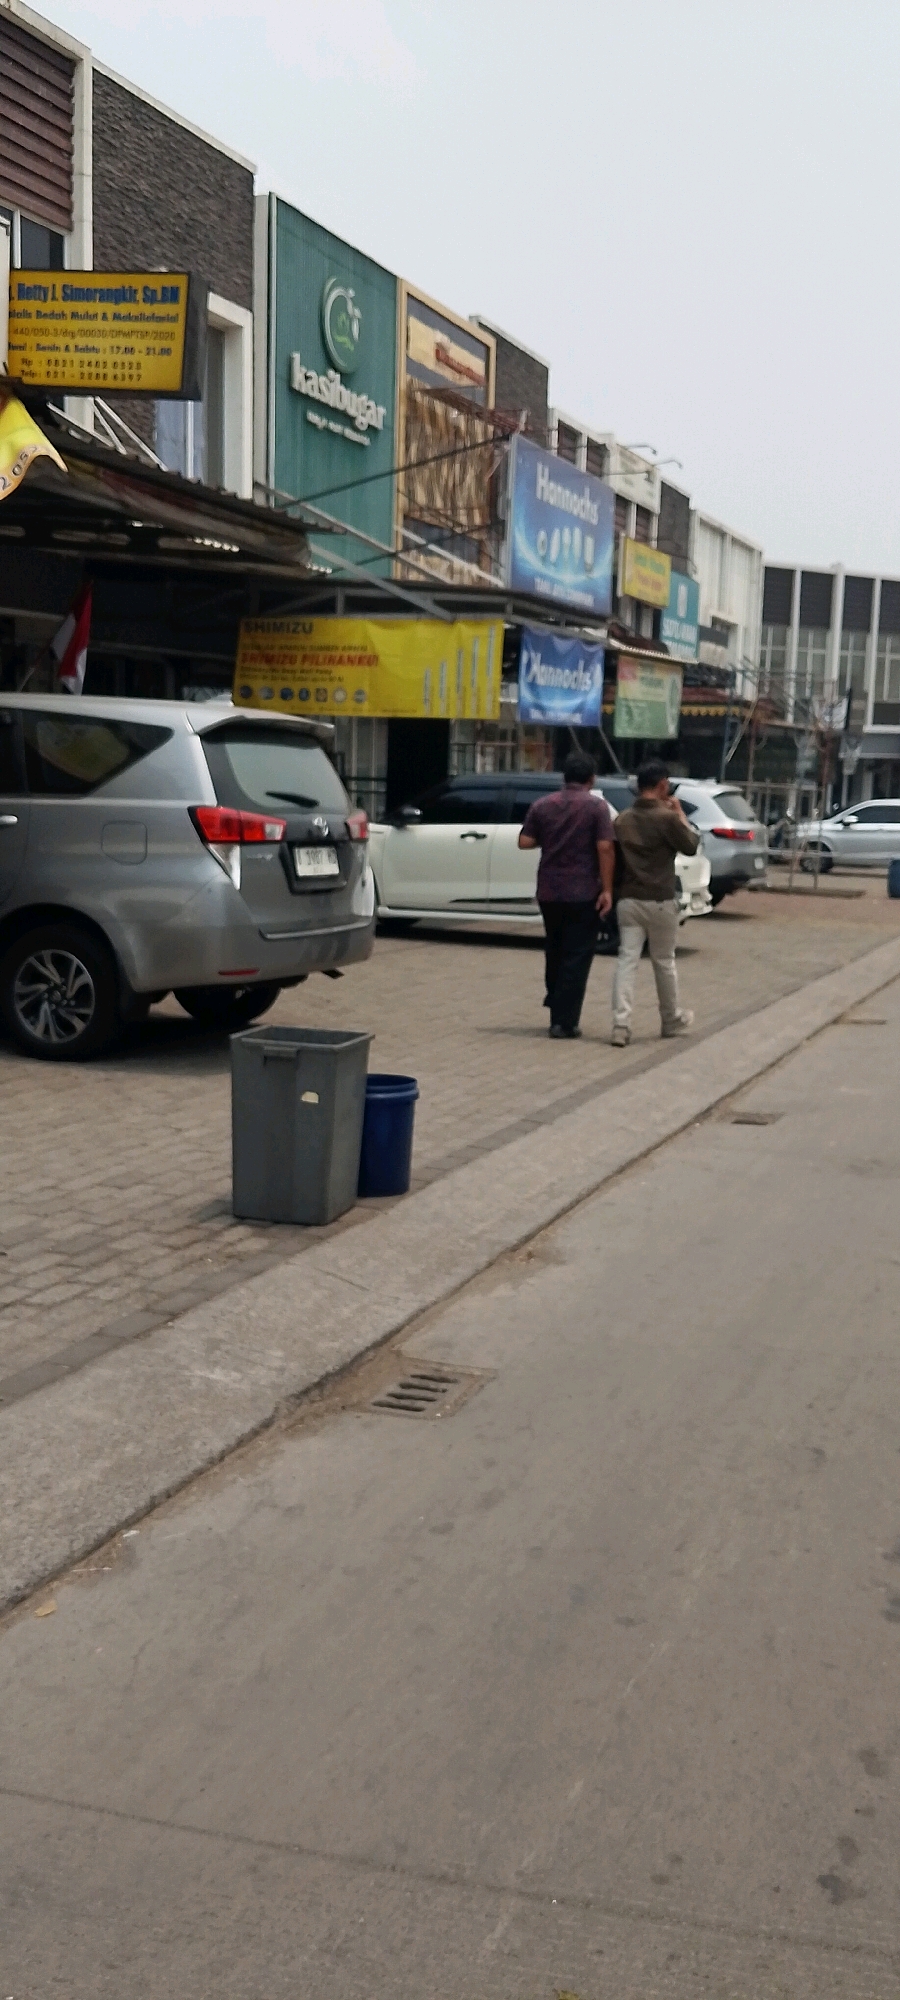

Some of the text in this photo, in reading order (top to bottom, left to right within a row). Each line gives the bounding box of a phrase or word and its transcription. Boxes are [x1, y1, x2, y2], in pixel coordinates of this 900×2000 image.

[35, 309, 68, 320] Bedah
[70, 311, 99, 322] Mulut
[101, 312, 109, 322] &
[64, 344, 71, 353] &
[290, 352, 387, 431] kasibugar
[243, 620, 314, 635] SHIMIZU
